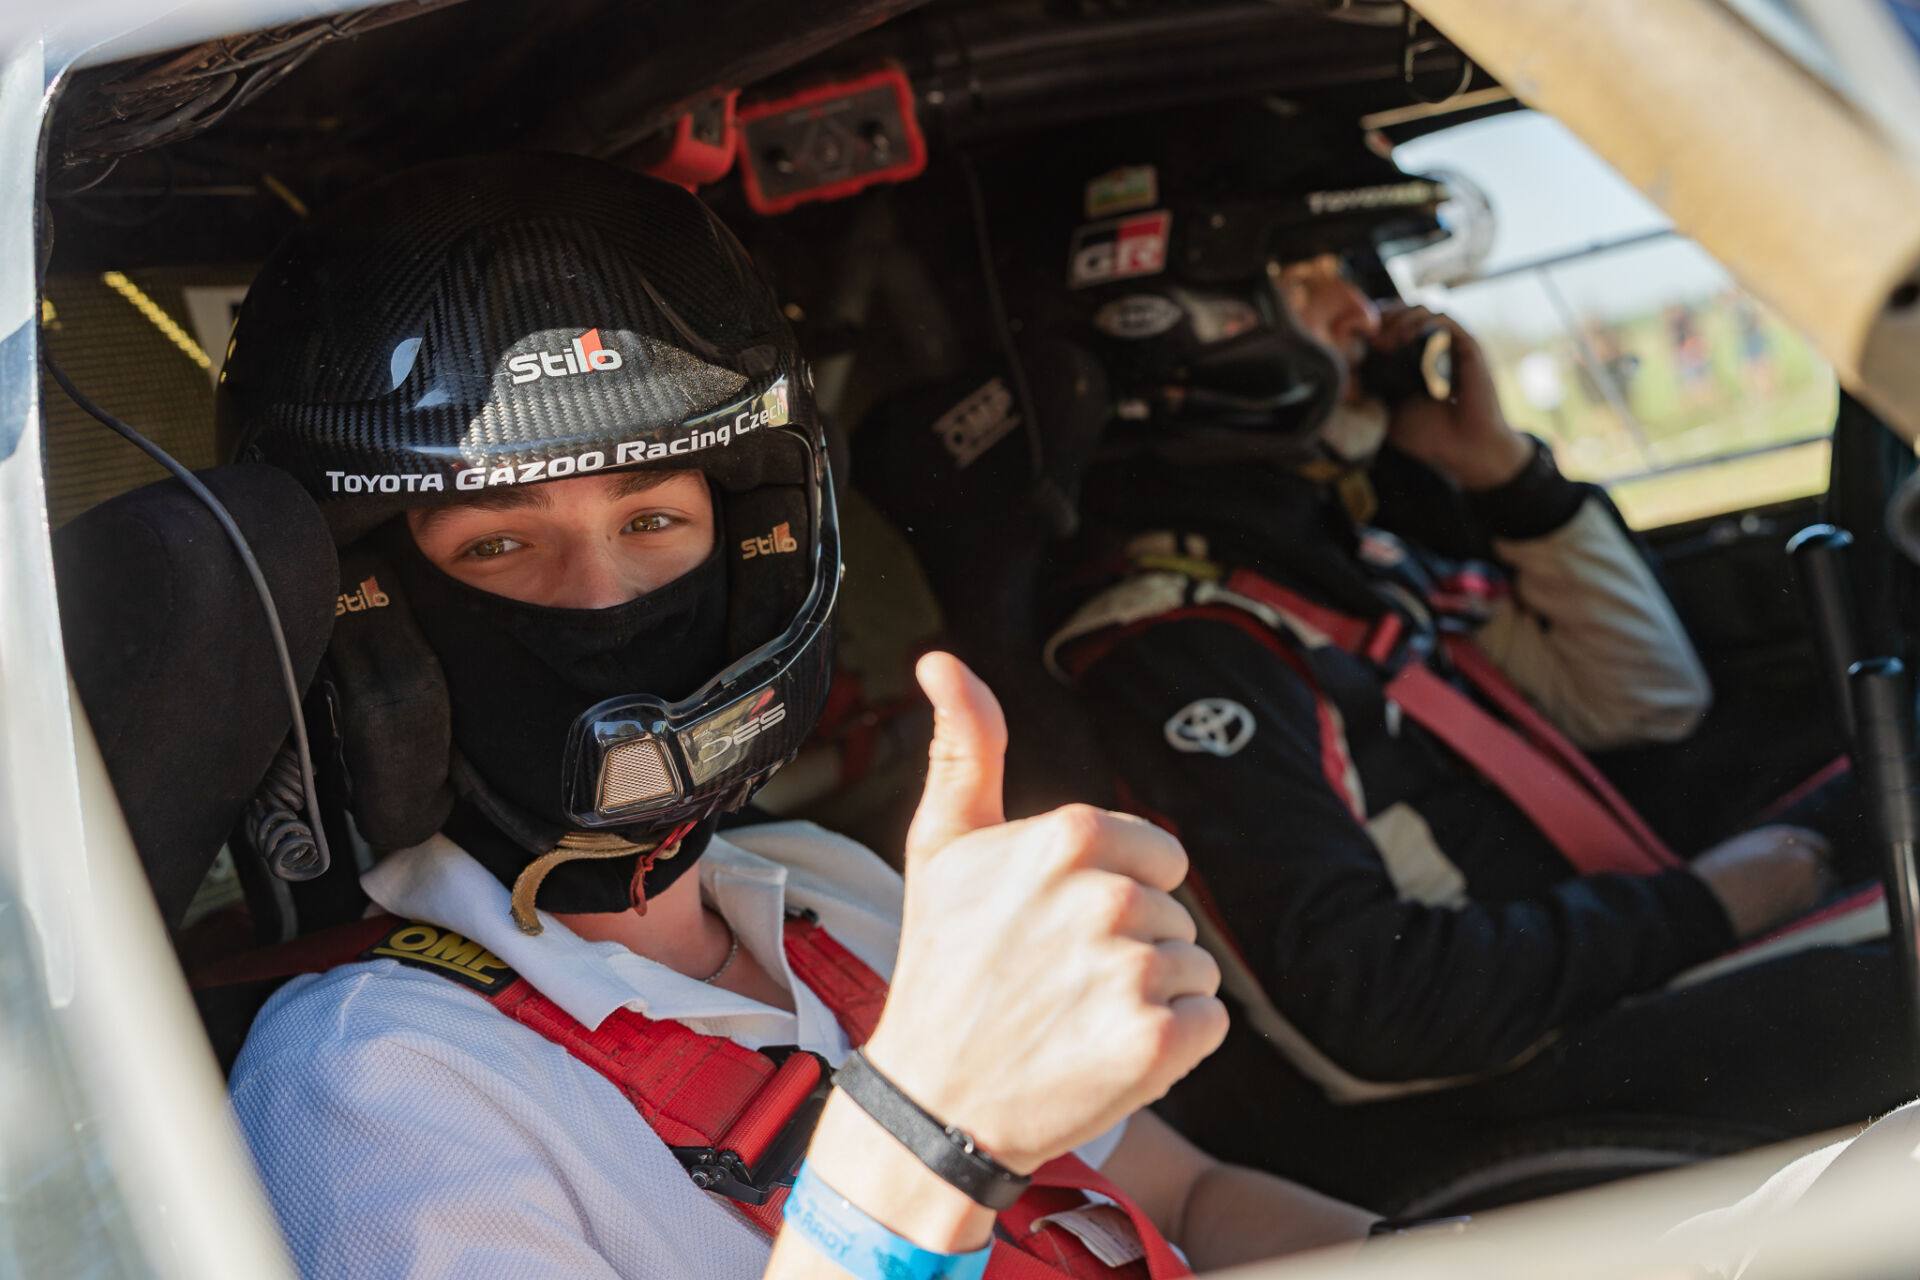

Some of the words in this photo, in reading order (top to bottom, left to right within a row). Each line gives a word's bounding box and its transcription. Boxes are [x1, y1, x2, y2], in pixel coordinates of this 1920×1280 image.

[508, 328, 622, 385] Stilo
[326, 471, 444, 492] TOYOTA
[456, 451, 604, 491] GAZOO
[616, 424, 730, 464] Racing
[735, 400, 784, 435] Czech
[741, 523, 798, 560] Stilo
